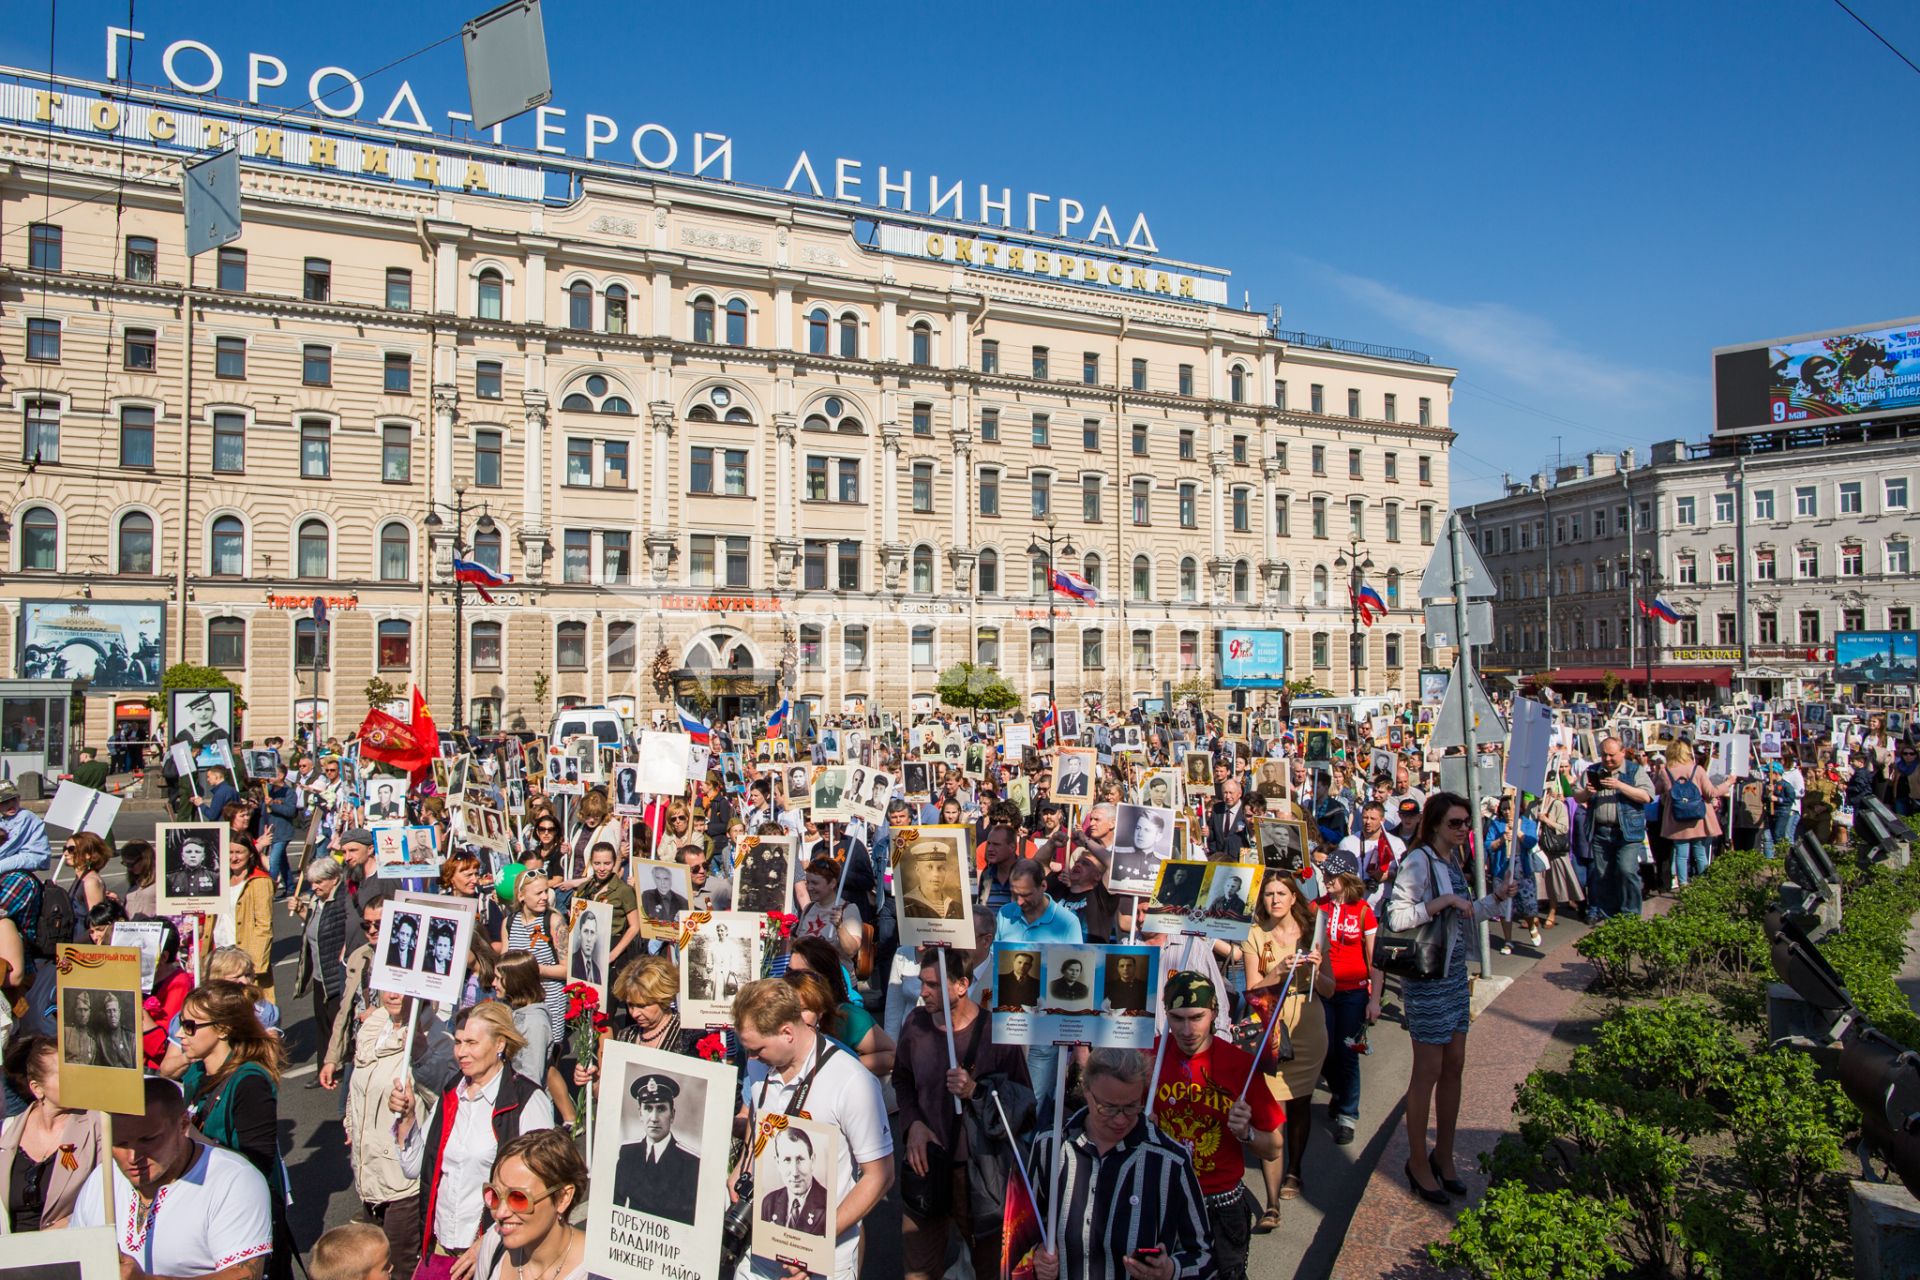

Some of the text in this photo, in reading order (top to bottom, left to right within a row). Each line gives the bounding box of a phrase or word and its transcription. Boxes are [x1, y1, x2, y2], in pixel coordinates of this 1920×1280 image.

[36, 91, 489, 189] ГОСТИНИЦА
[785, 150, 1159, 252] ЛЕНИНГРАД
[926, 232, 1196, 298] ОКТЯБРЬСКАЯ
[1773, 402, 1807, 422] 9 мая
[902, 602, 949, 614] БИСТРО
[1229, 639, 1241, 660] 9
[1673, 649, 1742, 660] РЕСТОРАН
[119, 953, 137, 962] ПОЛК
[1155, 1081, 1234, 1114] ОССИЯ
[611, 1210, 670, 1240] ГОРБУНОВ
[610, 1227, 681, 1260] ВЛАДИМИР
[609, 1247, 655, 1272] ИНЖЕНЕР
